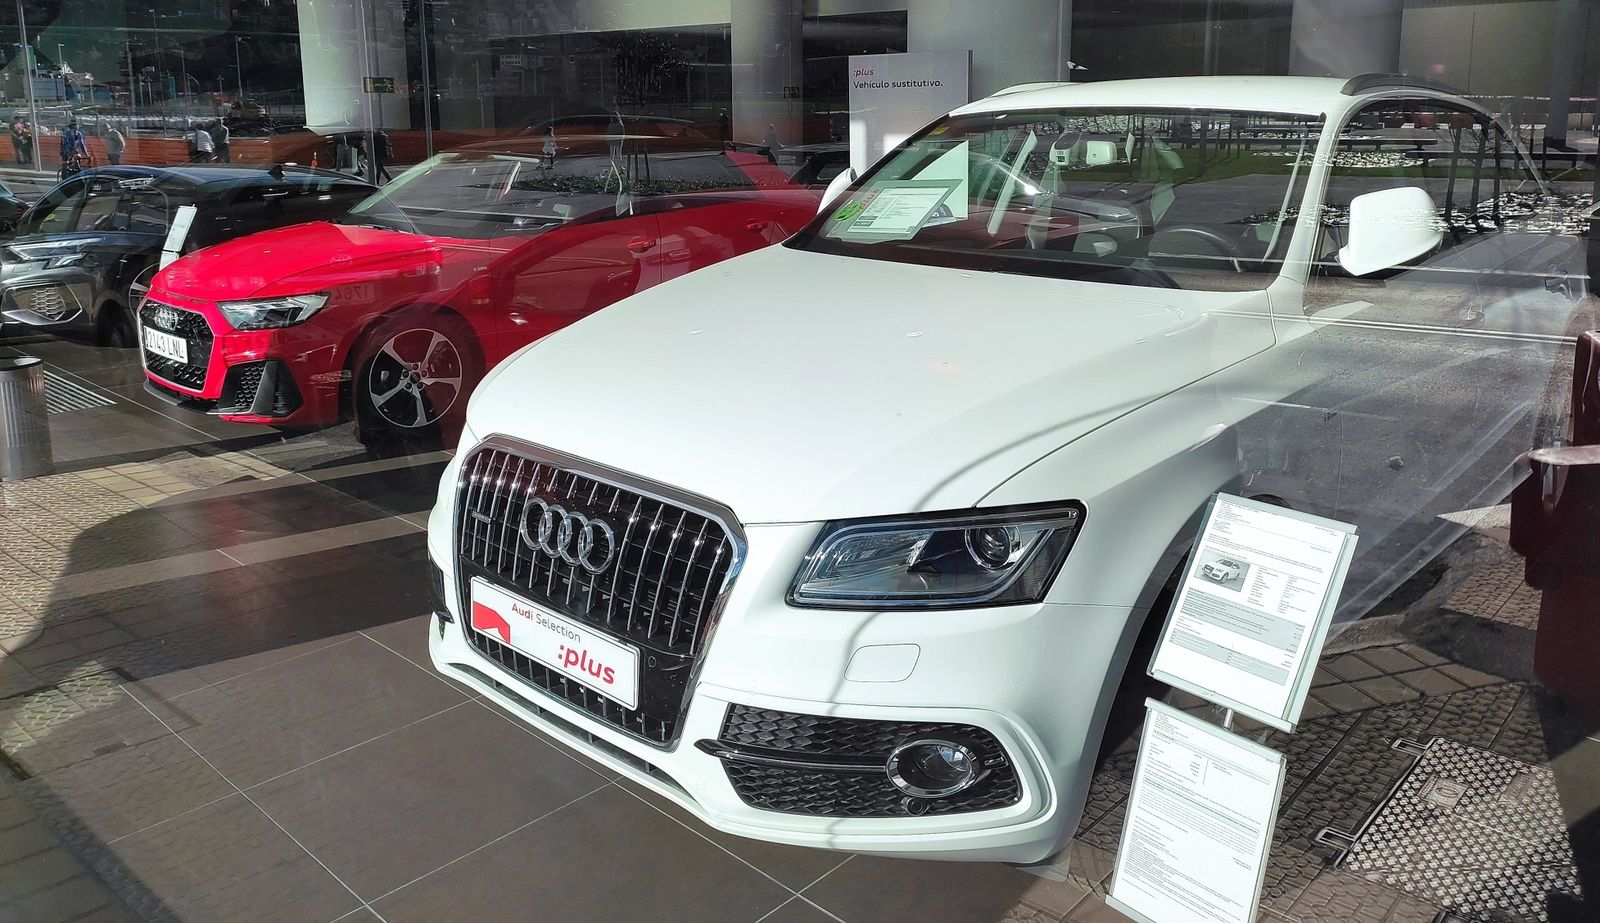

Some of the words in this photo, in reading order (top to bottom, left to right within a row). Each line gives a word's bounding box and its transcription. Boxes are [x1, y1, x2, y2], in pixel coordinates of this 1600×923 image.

[167, 337, 185, 360] LNL
[511, 602, 534, 621] Audi
[535, 613, 581, 643] Selection
[557, 644, 615, 685] :plus
